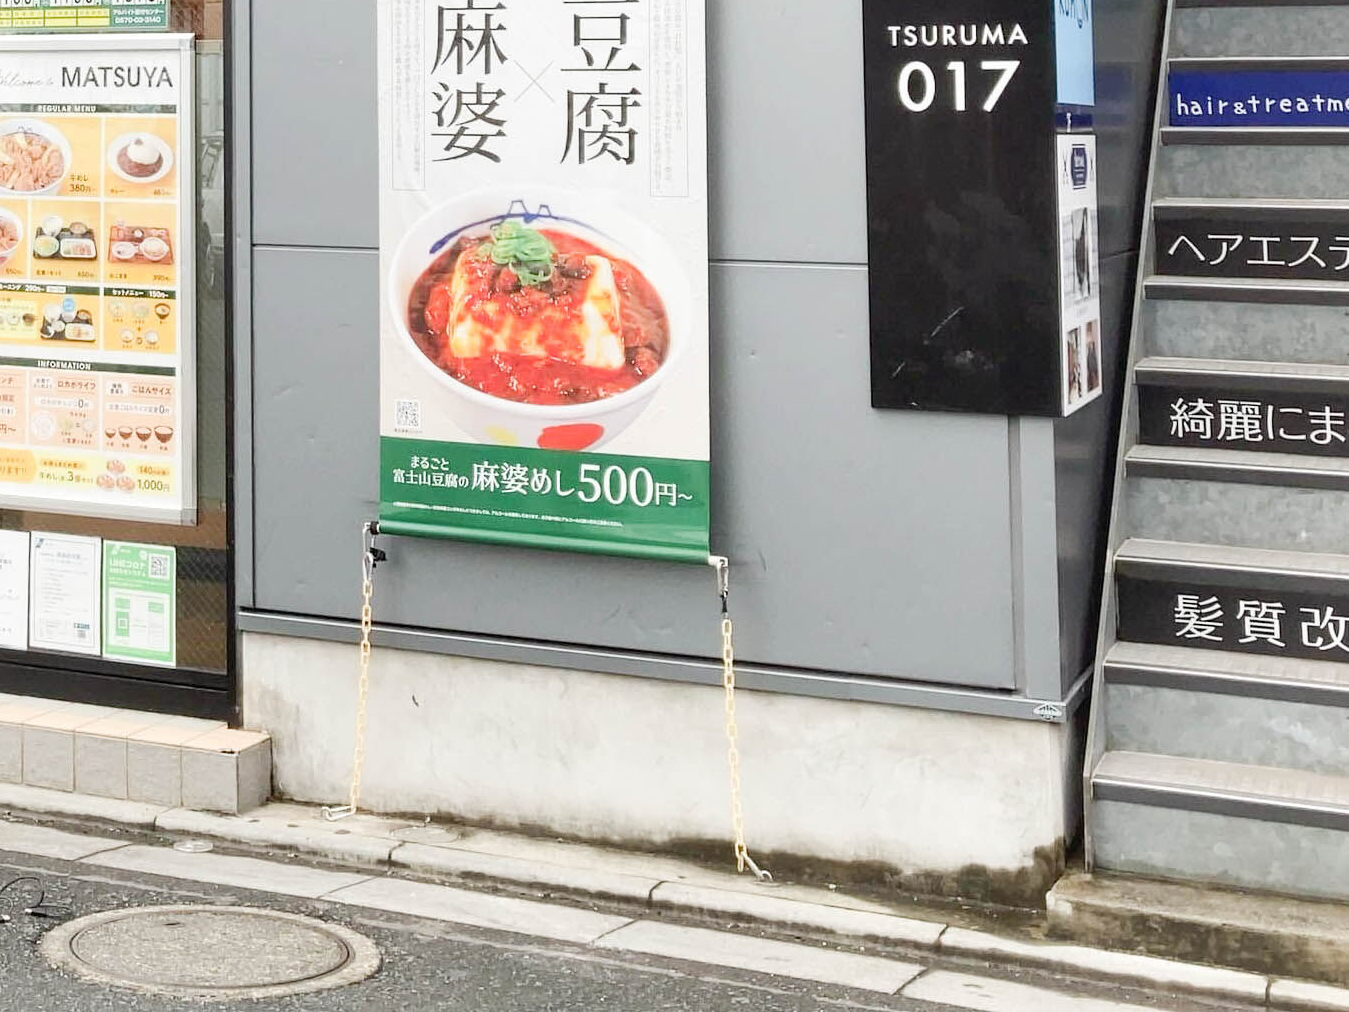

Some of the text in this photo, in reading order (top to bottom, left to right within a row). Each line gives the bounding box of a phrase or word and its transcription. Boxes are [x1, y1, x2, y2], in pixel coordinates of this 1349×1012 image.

[887, 23, 1030, 47] TSURUMA
[61, 65, 173, 88] MATSUYA
[897, 59, 1022, 114] 017
[37, 104, 97, 113] REGULAR MENU
[37, 359, 92, 371] INFORMATION
[1169, 396, 1346, 445] 綺麗にま
[410, 455, 450, 471] まるごと
[392, 468, 469, 489] 富士山豆腐の
[470, 460, 575, 497] 麻婆めし
[1173, 593, 1349, 652] 髪質改
